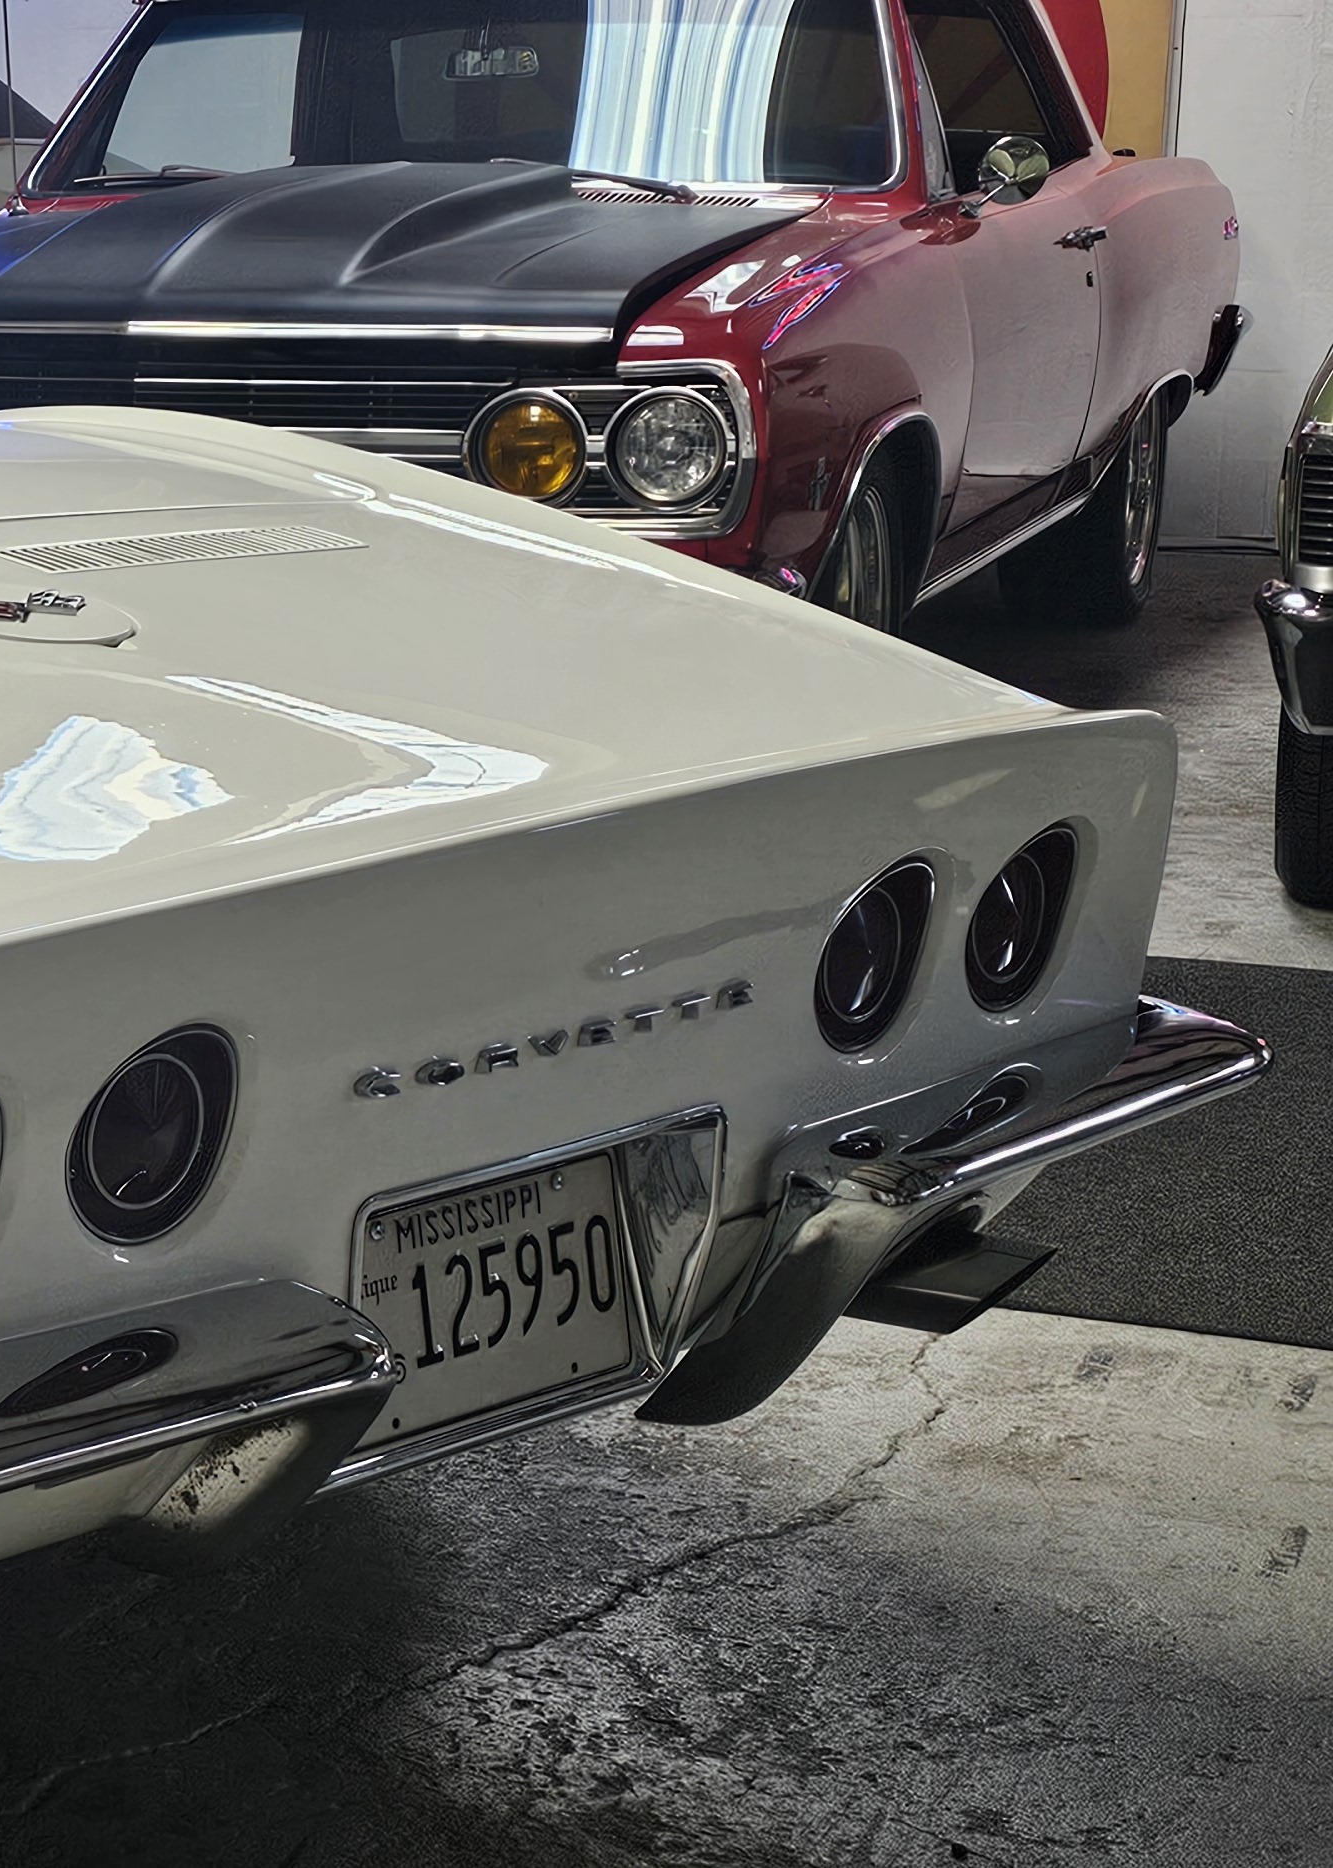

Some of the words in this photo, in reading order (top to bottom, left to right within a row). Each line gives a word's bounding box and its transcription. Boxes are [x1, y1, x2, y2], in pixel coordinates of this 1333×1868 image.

[352, 976, 754, 1099] CORVETTE
[393, 1180, 542, 1254] MISSISSIPPI
[361, 1274, 398, 1306] ique
[411, 1214, 617, 1369] 125950
